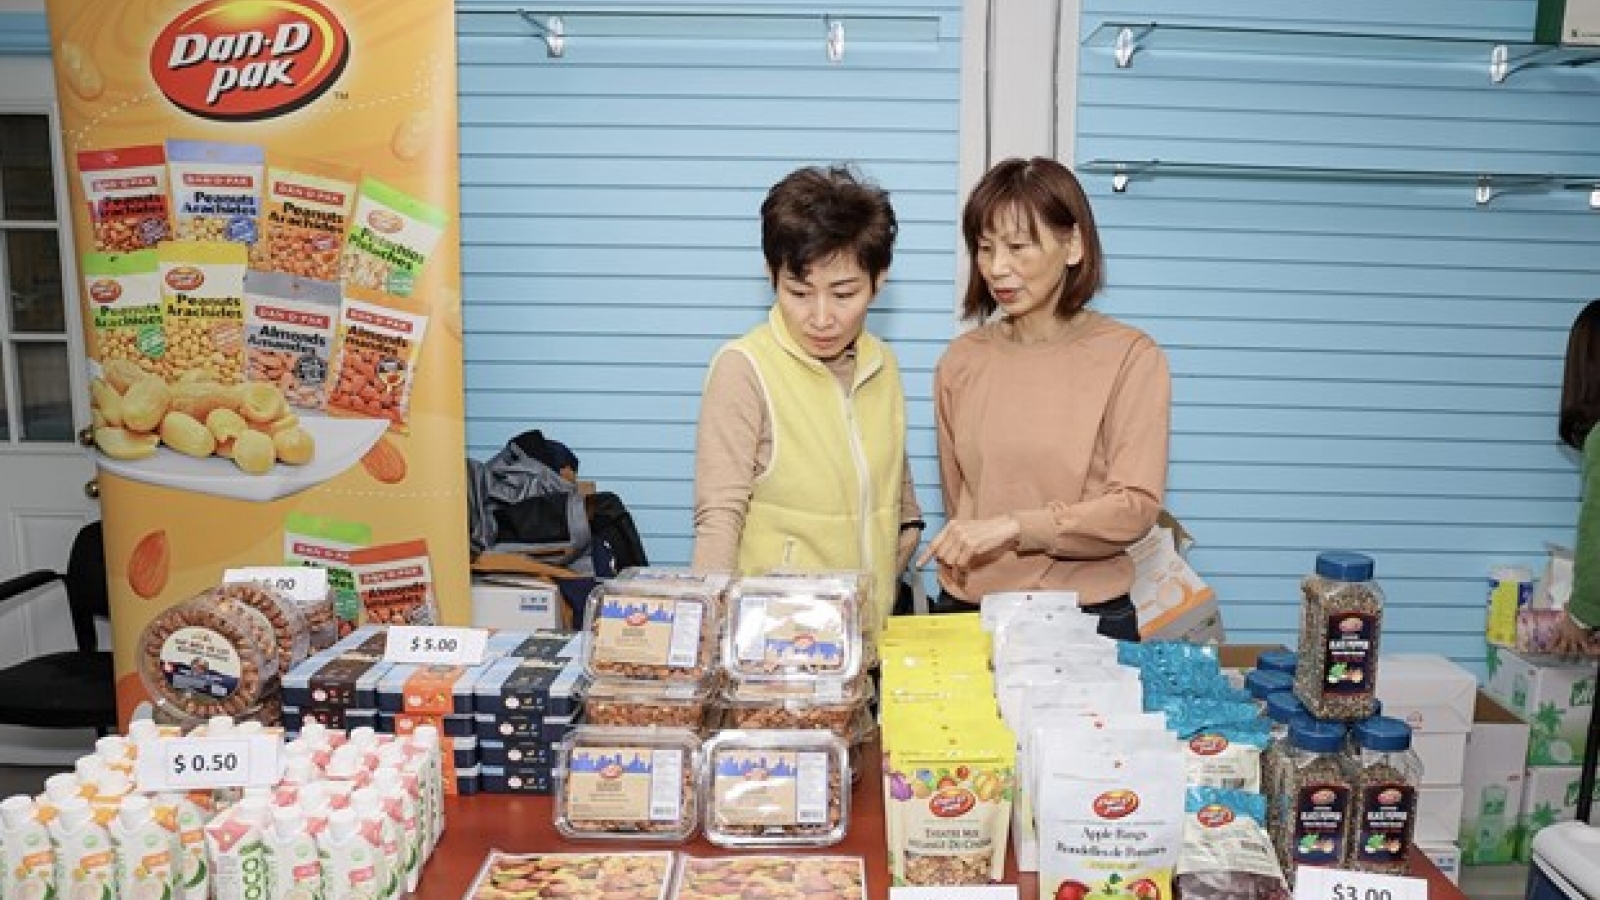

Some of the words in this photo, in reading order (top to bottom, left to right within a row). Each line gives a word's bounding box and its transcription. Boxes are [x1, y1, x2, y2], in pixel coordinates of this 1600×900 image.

[206, 60, 295, 104] pak
[194, 191, 254, 205] Peanuts
[283, 201, 344, 223] Peanuts
[177, 293, 241, 306] Peanuts
[260, 324, 326, 347] Almonds
[423, 638, 457, 652] 5.00
[174, 754, 186, 773] $
[193, 753, 238, 772] 0.50
[1333, 884, 1392, 900] $300
